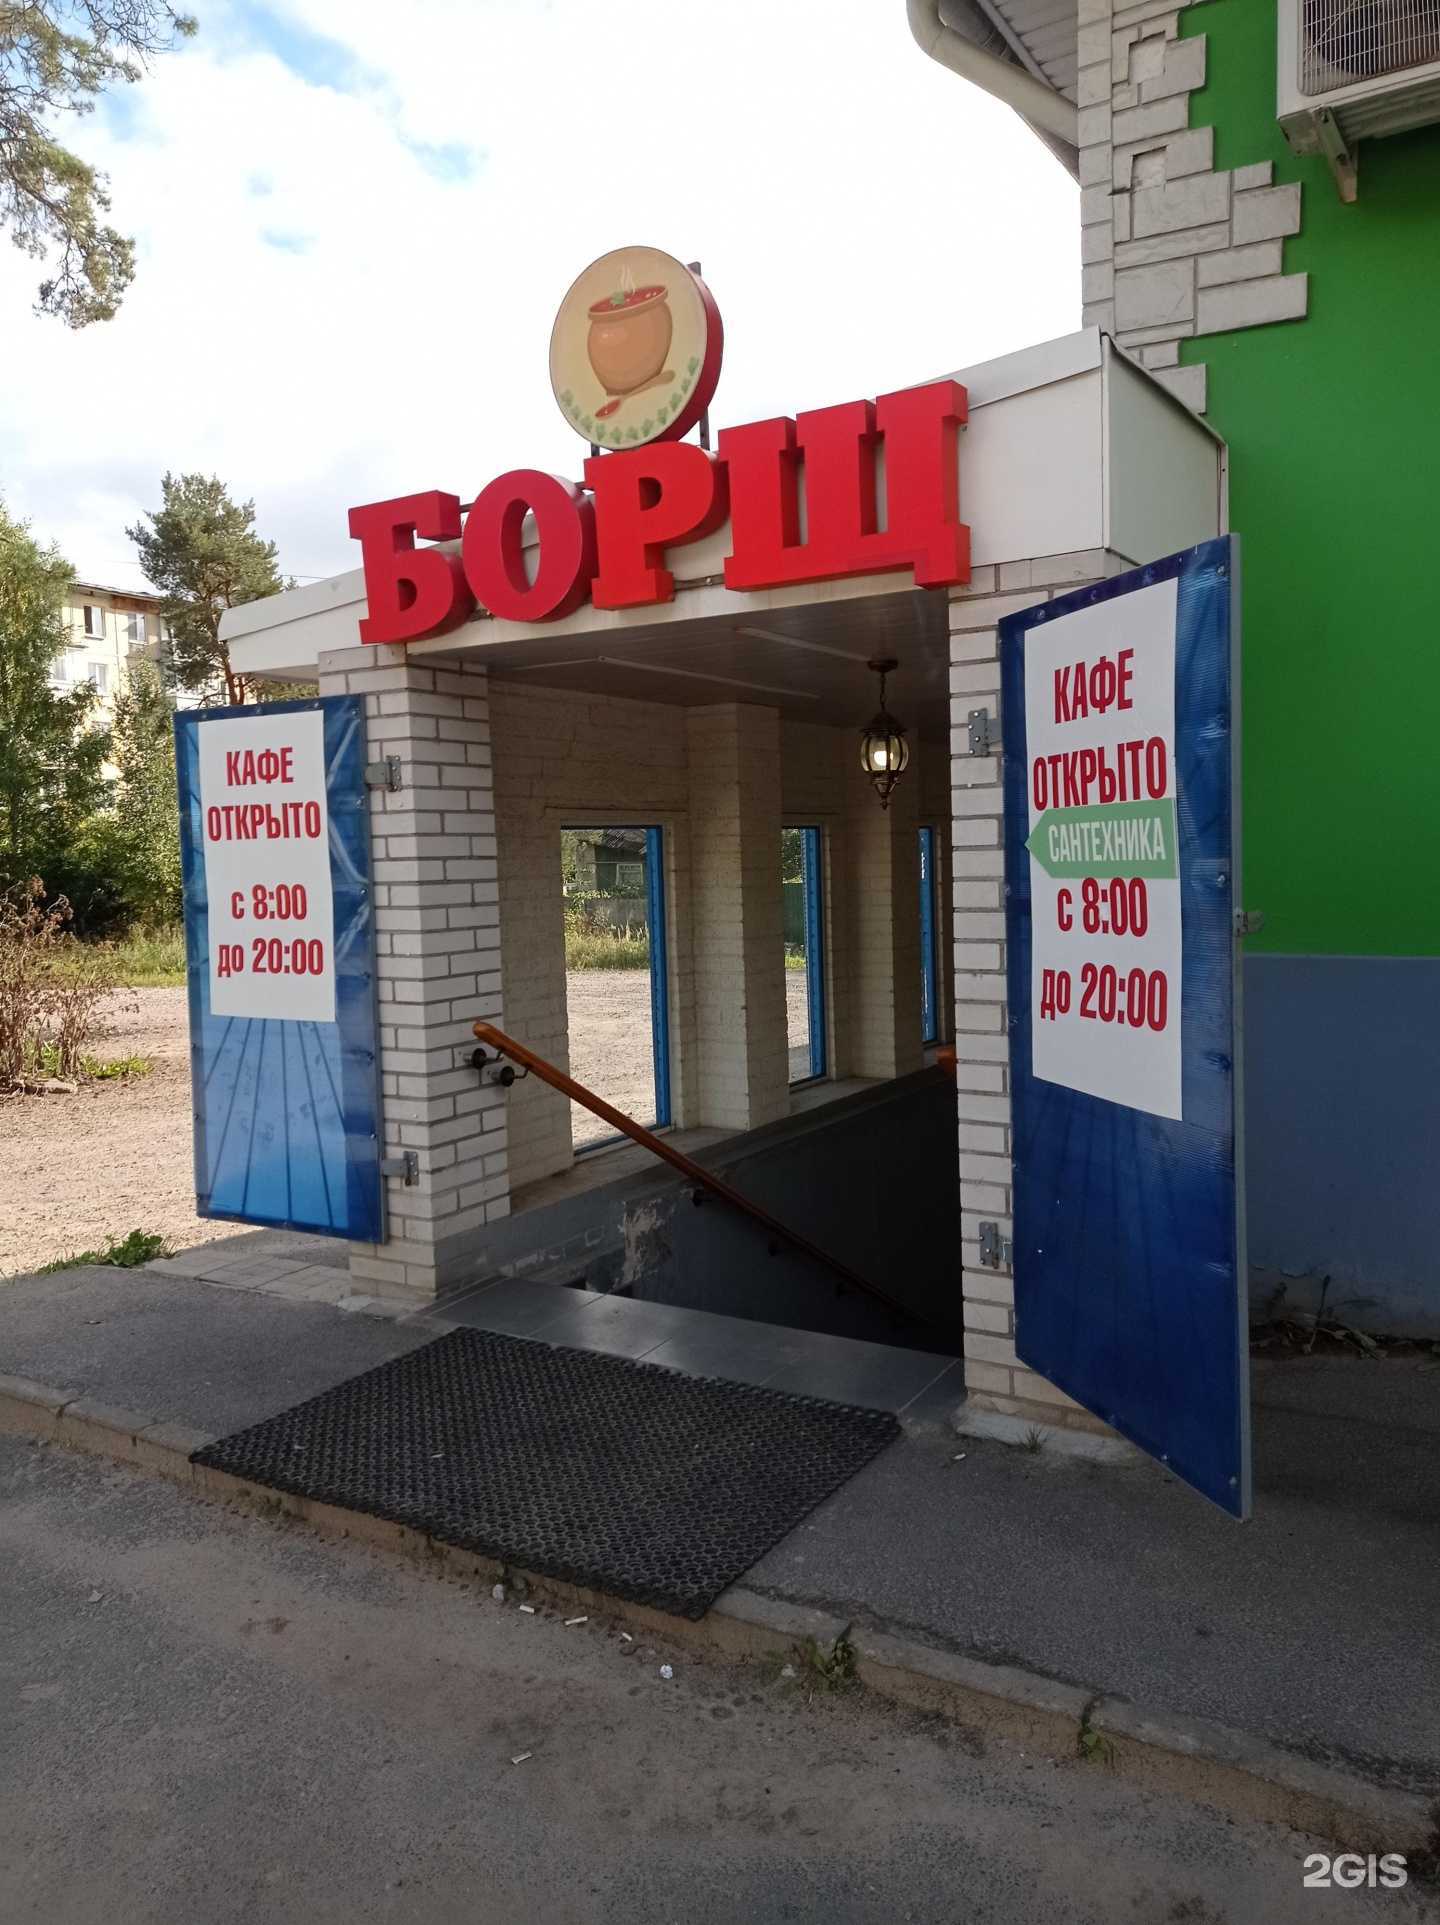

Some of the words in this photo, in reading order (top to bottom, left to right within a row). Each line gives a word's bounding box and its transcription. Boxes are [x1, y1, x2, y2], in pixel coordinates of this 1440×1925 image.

[348, 379, 970, 645] БОРЩ
[1054, 648, 1134, 724] КАФЕ
[226, 747, 294, 786] КАФЕ
[1033, 736, 1167, 811] ОТКРЫТО
[207, 801, 321, 842] ОТКРЫТО
[1048, 817, 1166, 862] САНТЕХНИКА
[252, 884, 307, 920] 8:00
[1082, 877, 1148, 937] 8:00
[217, 944, 244, 977] до
[252, 938, 324, 976] 20:00
[1040, 968, 1072, 1021] до
[1080, 962, 1167, 1032] 20:00
